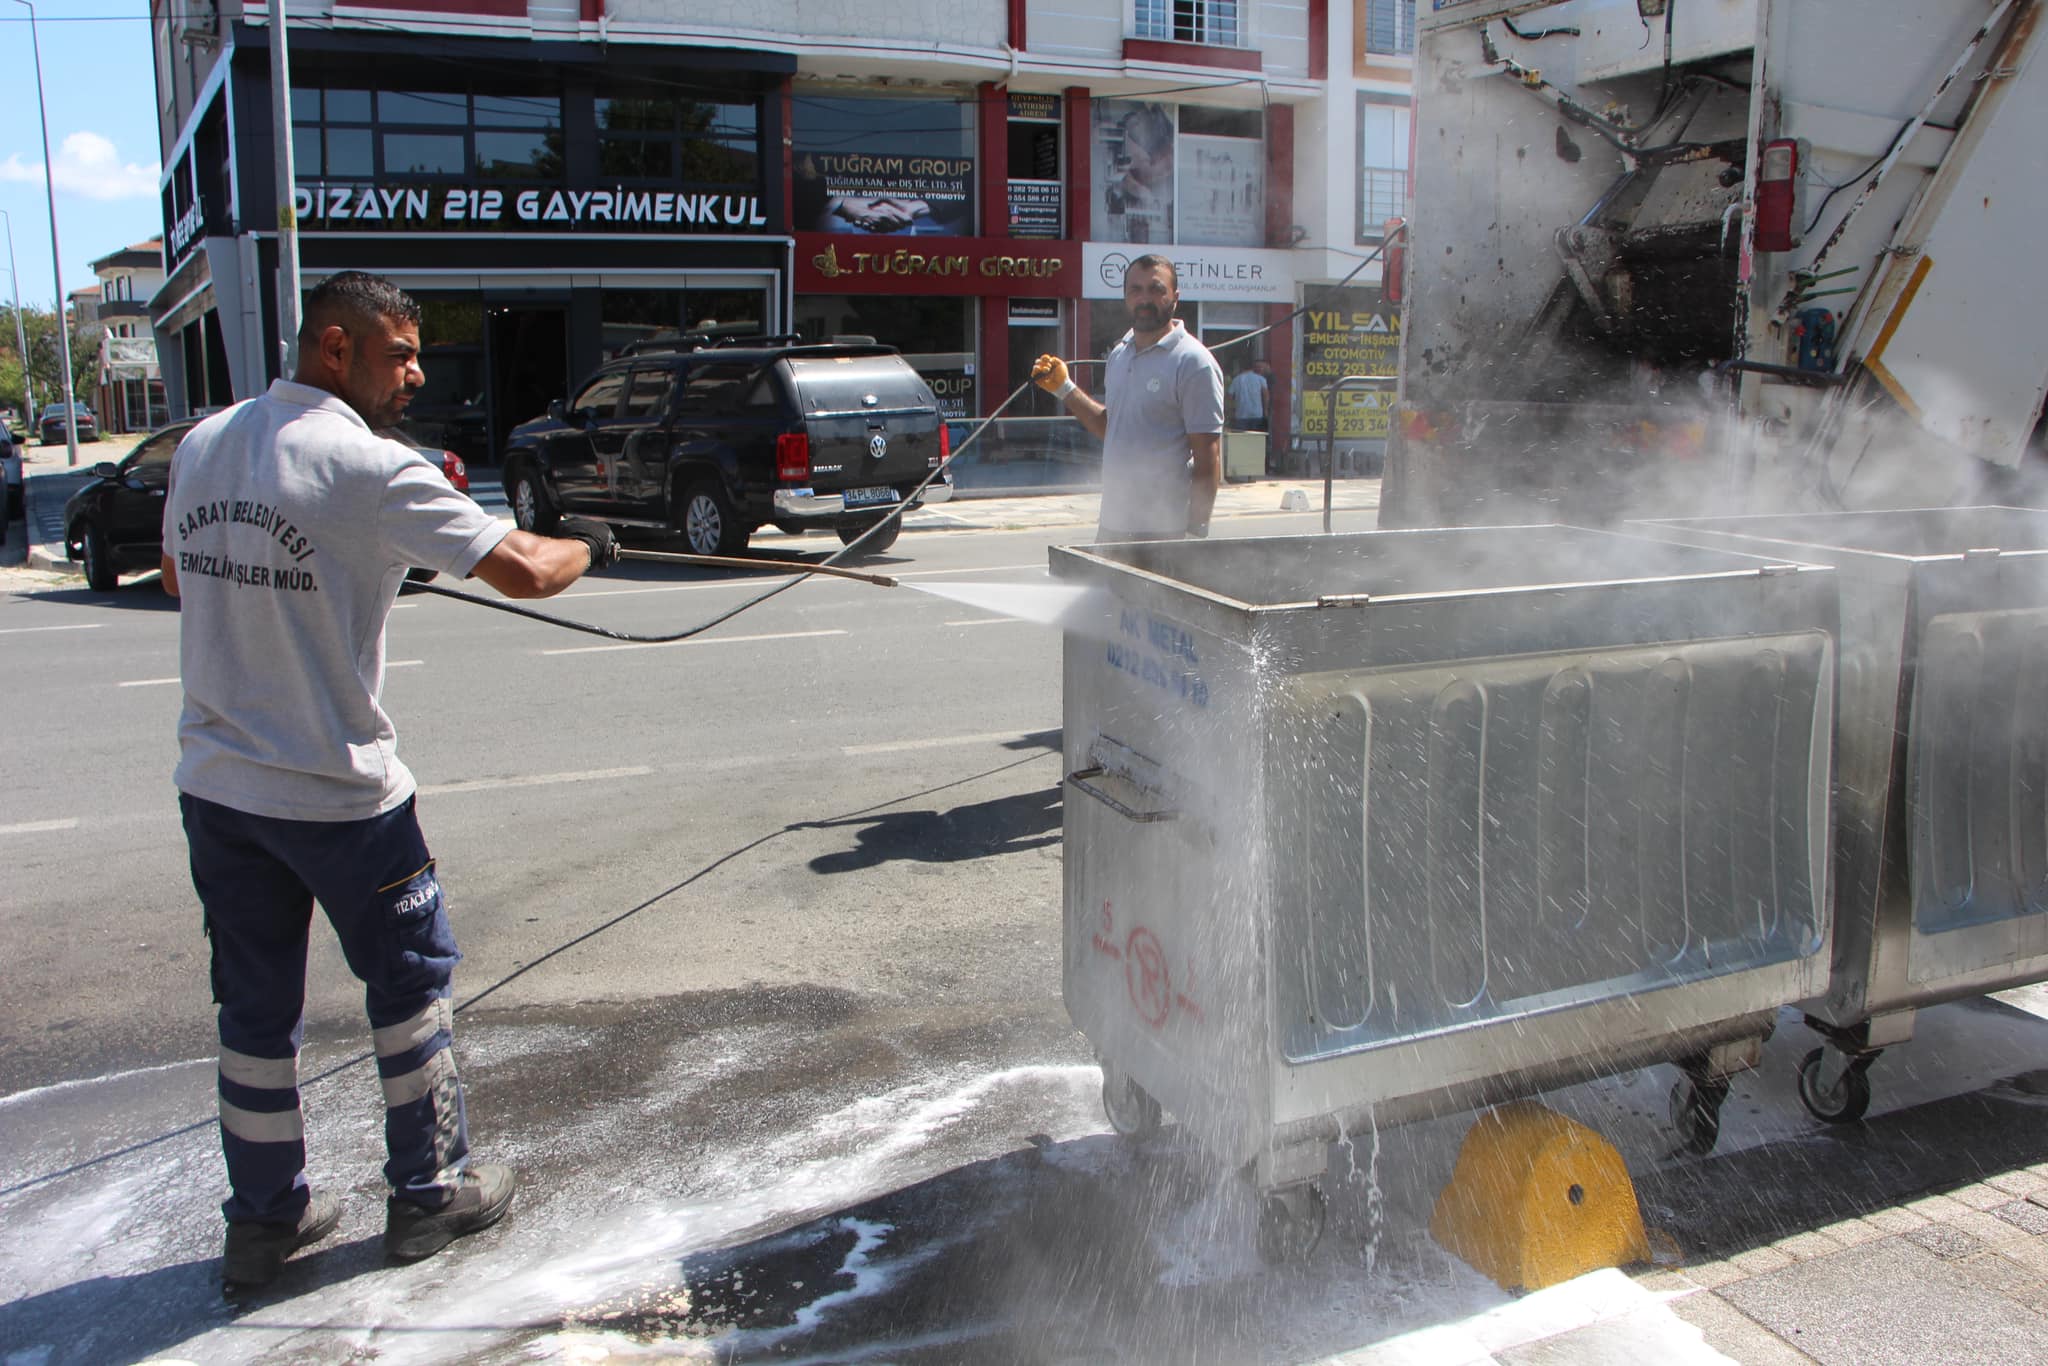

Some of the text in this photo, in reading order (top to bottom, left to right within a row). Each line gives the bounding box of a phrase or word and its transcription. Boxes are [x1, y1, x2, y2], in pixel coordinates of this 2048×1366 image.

[820, 154, 972, 176] TUĞRAM GROUP
[295, 181, 767, 225] DİZAYN 212 GAYRİMENKUL
[852, 249, 1063, 277] TUĞRAM GROUP
[1174, 258, 1263, 279] ETİNLER
[1309, 333, 1349, 345] EMLAK
[1306, 361, 1340, 376] 0532
[1343, 362, 1367, 376] 293
[1320, 392, 1393, 408] YLSAN
[178, 499, 229, 541] SARAY
[179, 549, 235, 582] EMİZLİK
[274, 567, 318, 592] MÜD.
